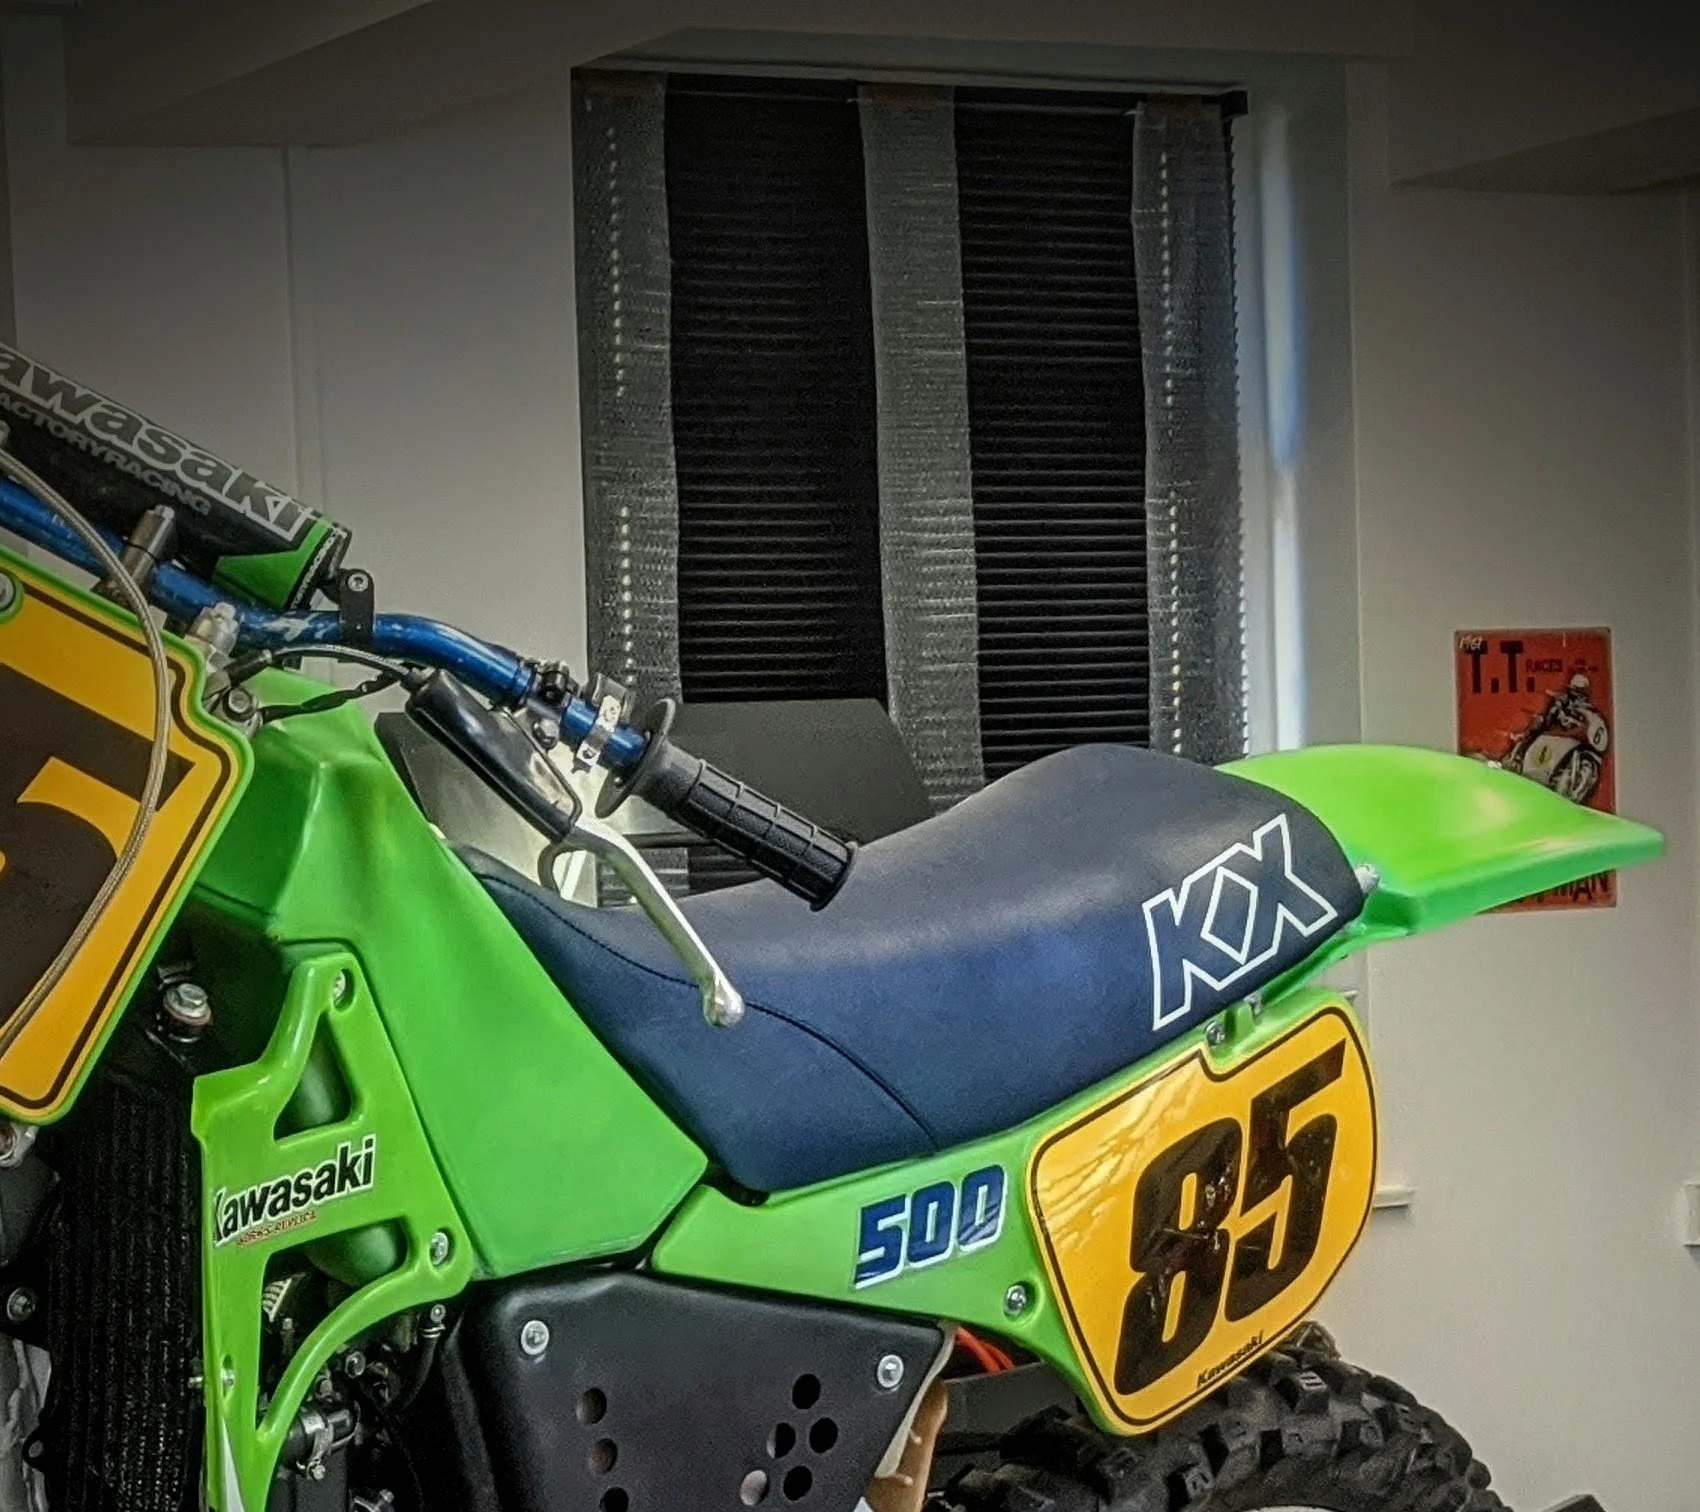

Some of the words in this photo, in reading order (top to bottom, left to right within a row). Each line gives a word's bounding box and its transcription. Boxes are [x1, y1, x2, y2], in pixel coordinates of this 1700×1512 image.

[1525, 658, 1563, 673] RACES
[1593, 727, 1605, 744] 6
[1142, 813, 1338, 1031] KX
[854, 1164, 1007, 1290] 500
[1113, 1037, 1347, 1396] 85
